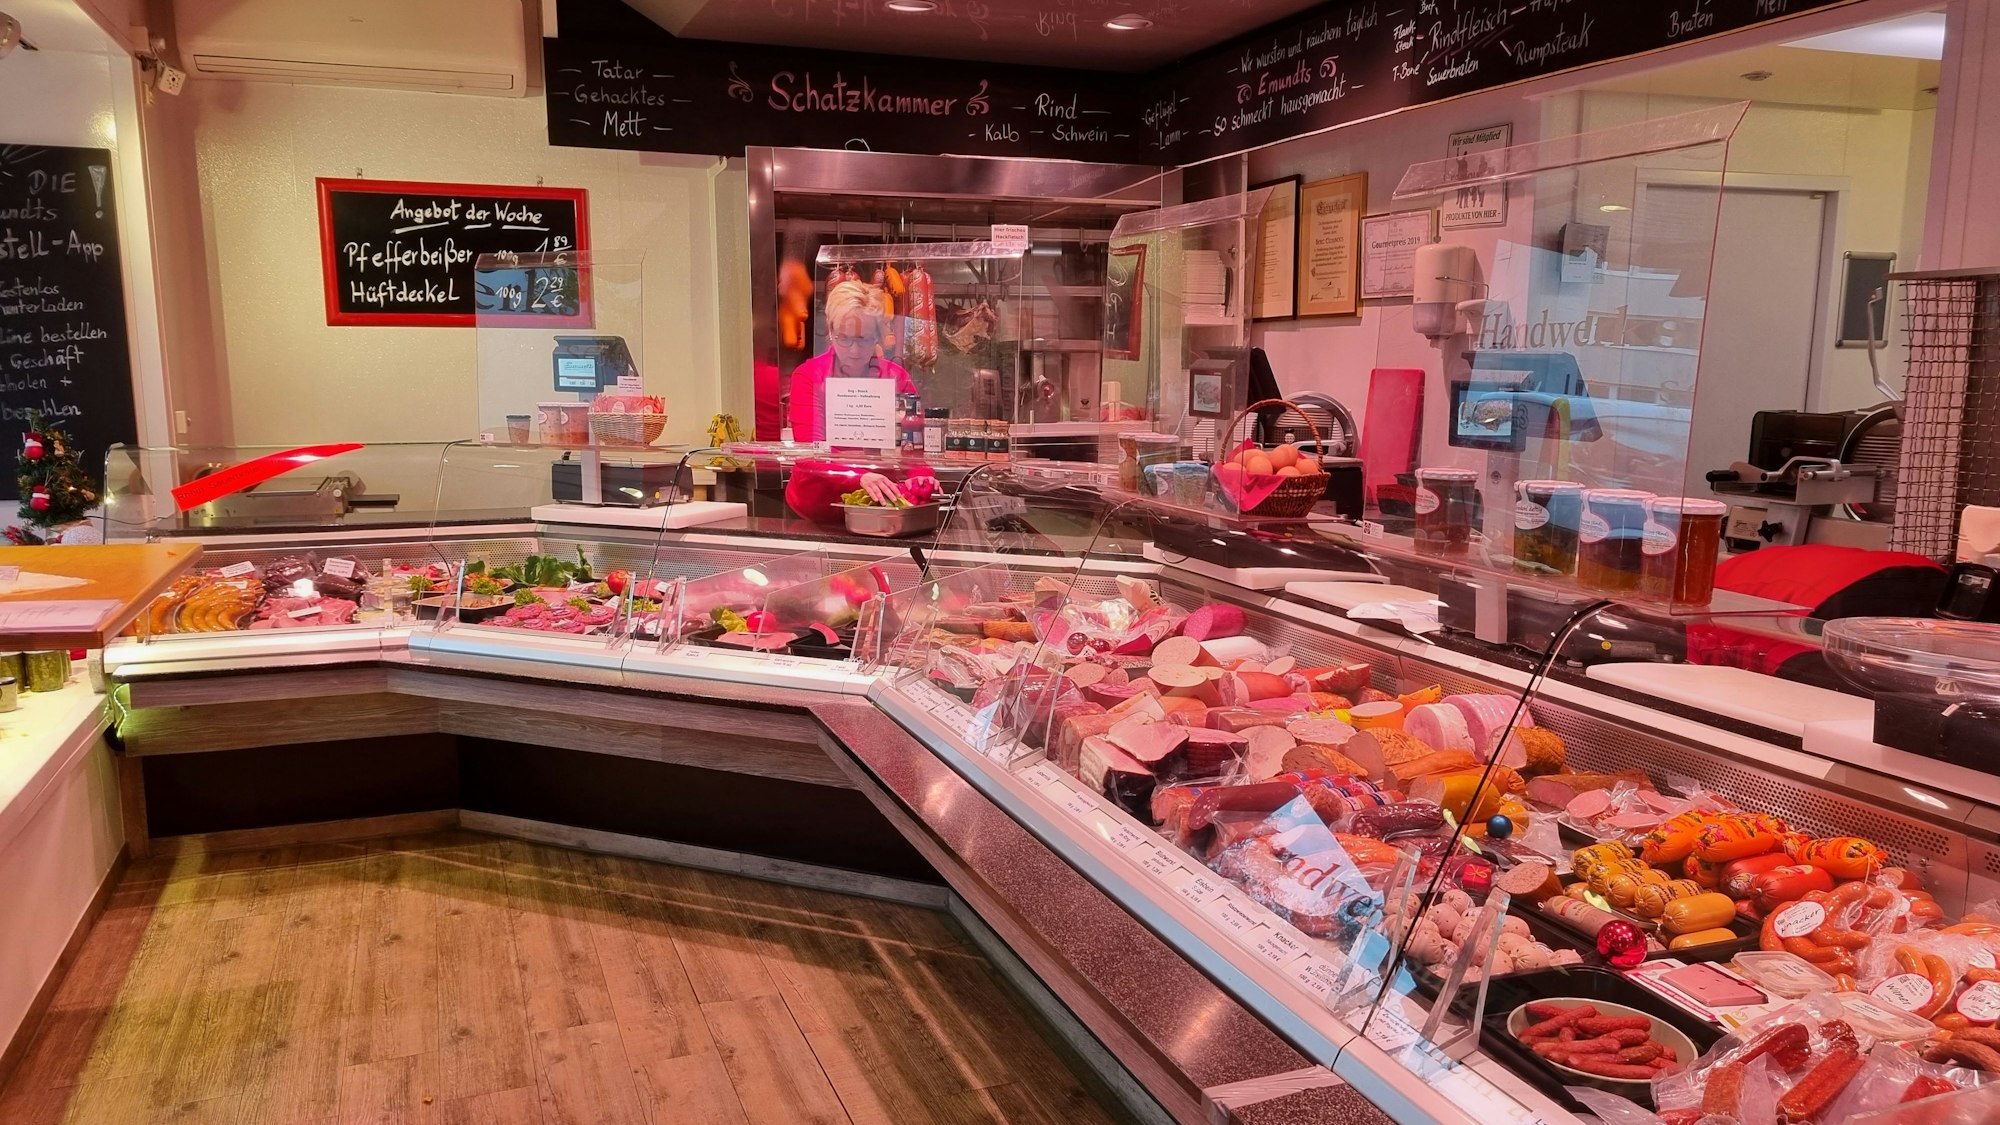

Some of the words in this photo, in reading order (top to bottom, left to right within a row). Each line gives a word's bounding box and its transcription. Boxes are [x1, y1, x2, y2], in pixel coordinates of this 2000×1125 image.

[1667, 11, 1713, 39] Braten
[1514, 13, 1595, 66] Rumpsteak
[592, 60, 644, 80] Tatar
[1258, 59, 1312, 95] Emundts
[1427, 51, 1479, 86] Sauerbraten
[574, 84, 665, 106] Gehacktes
[768, 71, 958, 116] Schatzkammer
[1035, 93, 1077, 120] Rind
[1231, 100, 1273, 131] schmeckt
[1281, 73, 1347, 116] hausgemacht
[603, 111, 647, 137] Mett
[985, 124, 1020, 142] Kalb
[1052, 124, 1108, 143] Schwein
[28, 169, 76, 194] DIE
[390, 198, 461, 224] Angebot
[465, 203, 490, 221] der
[495, 202, 543, 224] Woche
[343, 237, 473, 274] Pfefferbeißer
[351, 278, 460, 308] Hüftdeckel
[41, 322, 107, 343] bestellen
[1273, 931, 1299, 950] Knacker
